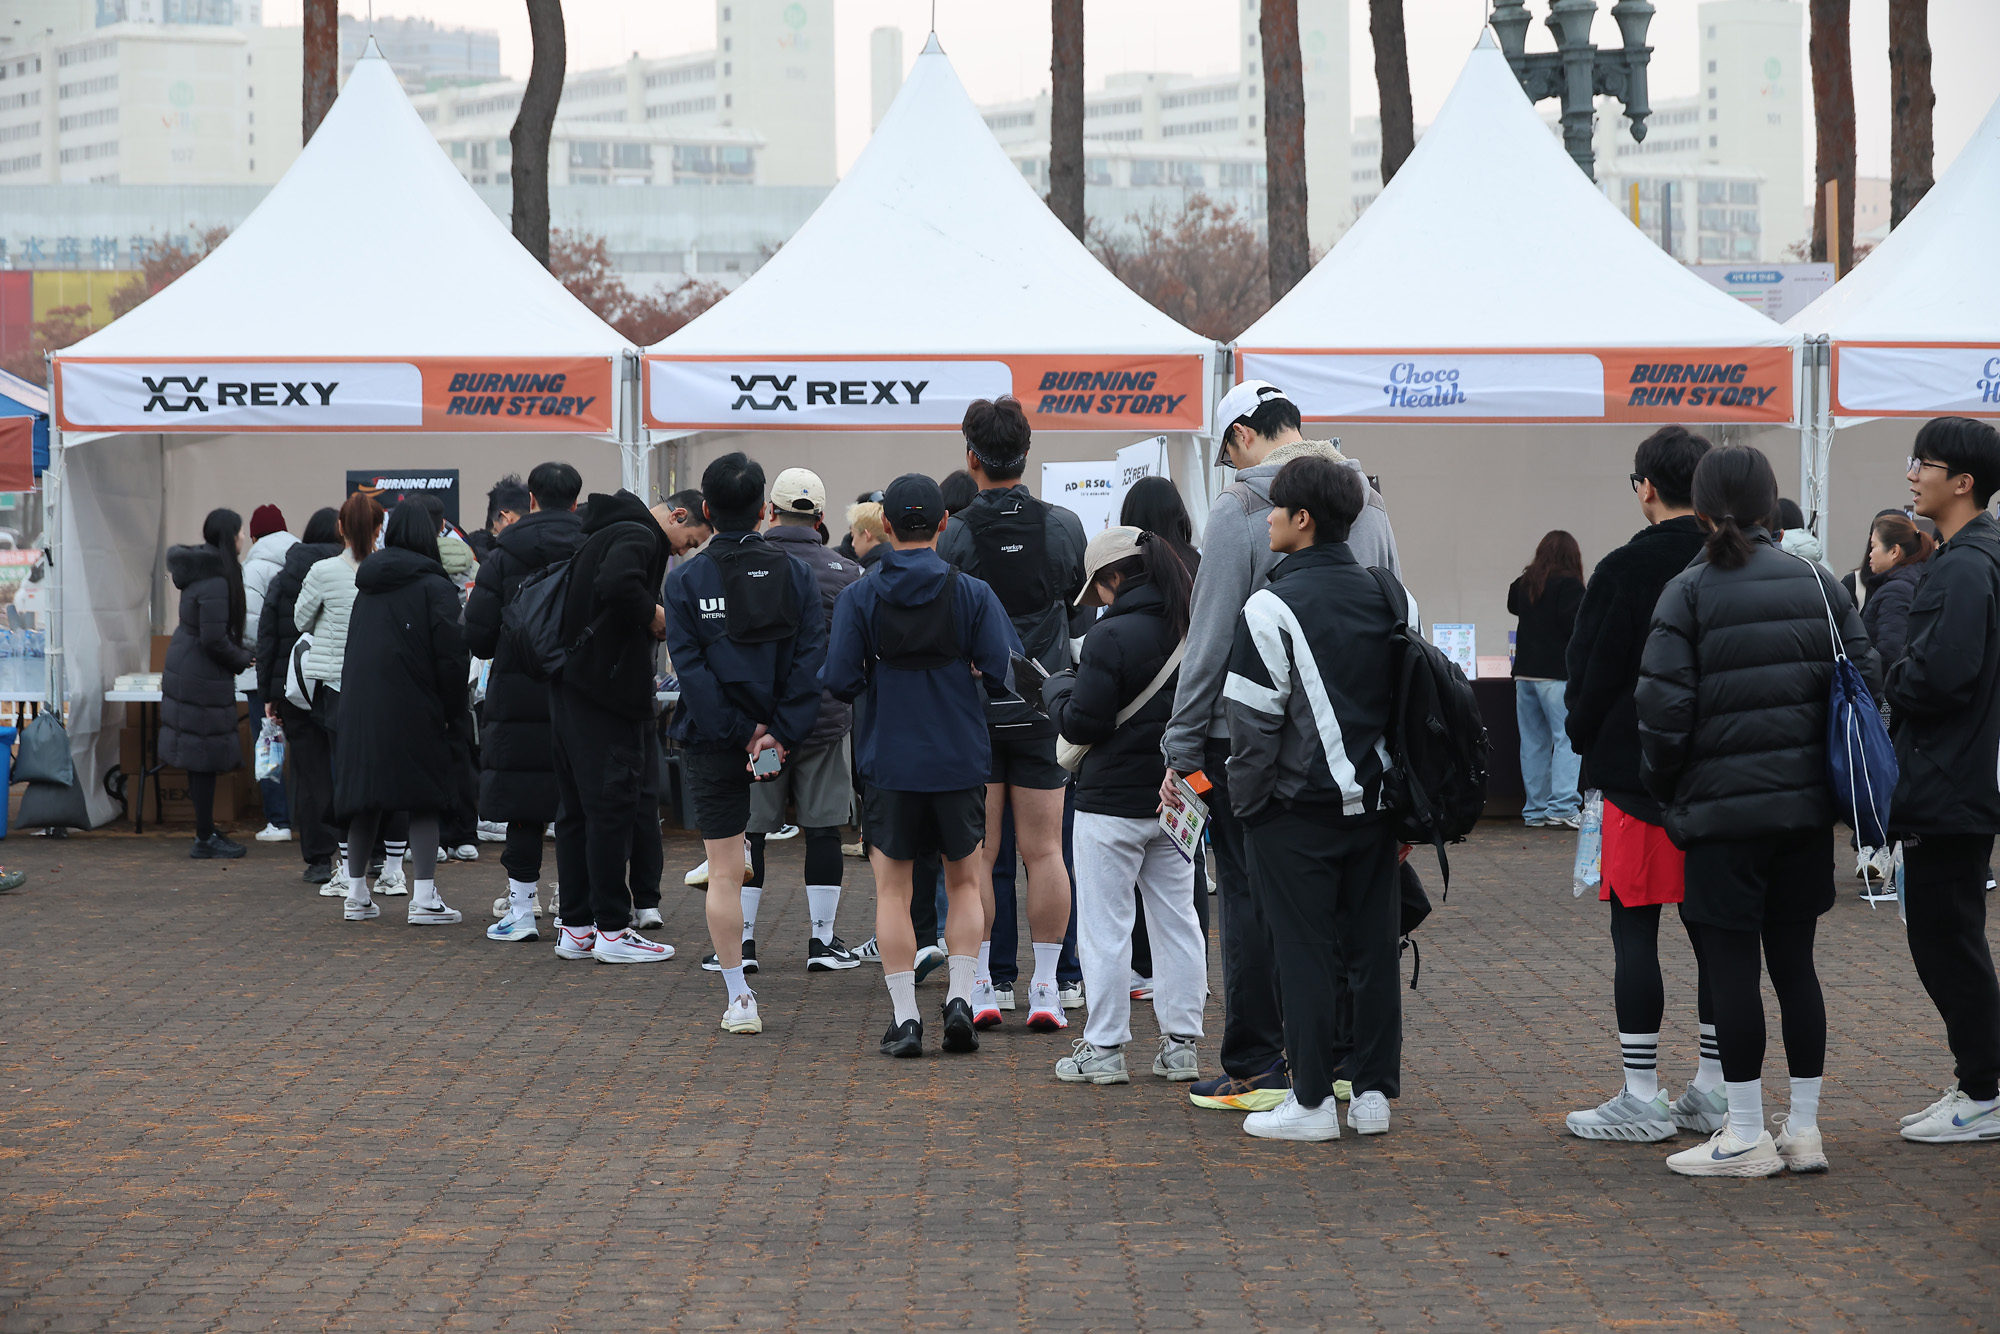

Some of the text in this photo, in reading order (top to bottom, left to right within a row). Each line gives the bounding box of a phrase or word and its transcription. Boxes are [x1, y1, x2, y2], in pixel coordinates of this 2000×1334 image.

[448, 373, 567, 393] BURNING
[1038, 371, 1158, 391] BURNING
[1389, 362, 1460, 385] Choco
[1629, 364, 1748, 384] BURNING
[217, 382, 339, 406] REXY
[806, 380, 929, 405] REXY
[1383, 382, 1467, 408] Health
[1628, 386, 1778, 406] RUN STORY
[446, 396, 596, 416] RUN STORY
[1036, 394, 1187, 414] RUN STORY
[1132, 464, 1150, 481] REXY
[375, 477, 453, 490] BURNING RUN
